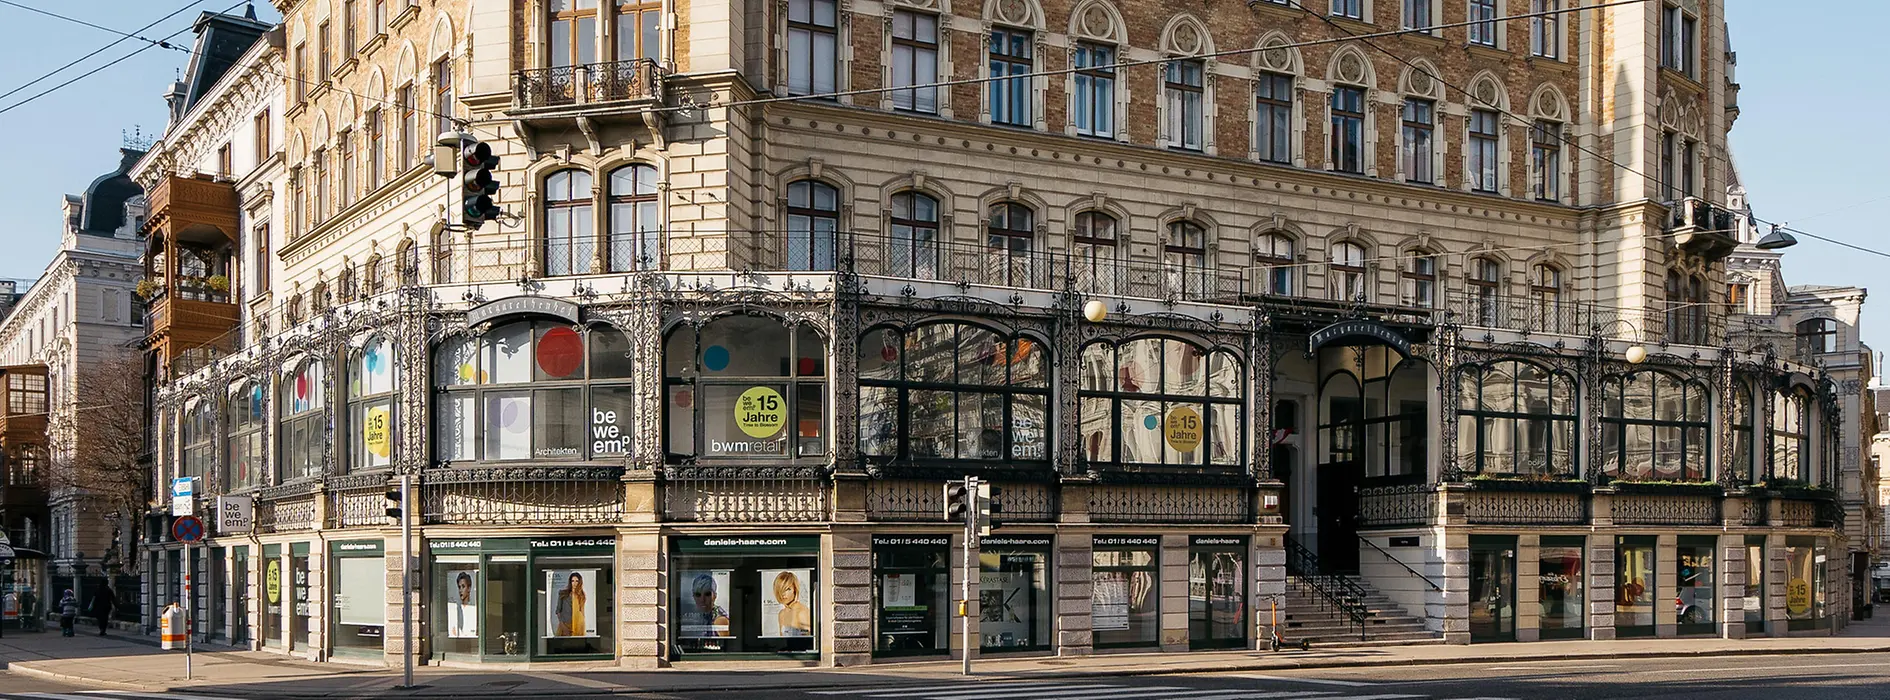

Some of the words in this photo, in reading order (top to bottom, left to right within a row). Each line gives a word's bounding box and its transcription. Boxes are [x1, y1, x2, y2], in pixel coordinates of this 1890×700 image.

[757, 395, 778, 411] 15
[373, 414, 383, 430] 15
[593, 407, 616, 424] be
[743, 412, 778, 423] Jahre
[1181, 415, 1197, 430] 15
[593, 425, 619, 439] we
[1170, 429, 1197, 440] Jahre
[535, 447, 577, 456] Architekten
[225, 501, 239, 511] be
[296, 567, 305, 585] be
[296, 586, 306, 600] we
[1795, 584, 1806, 596] 15
